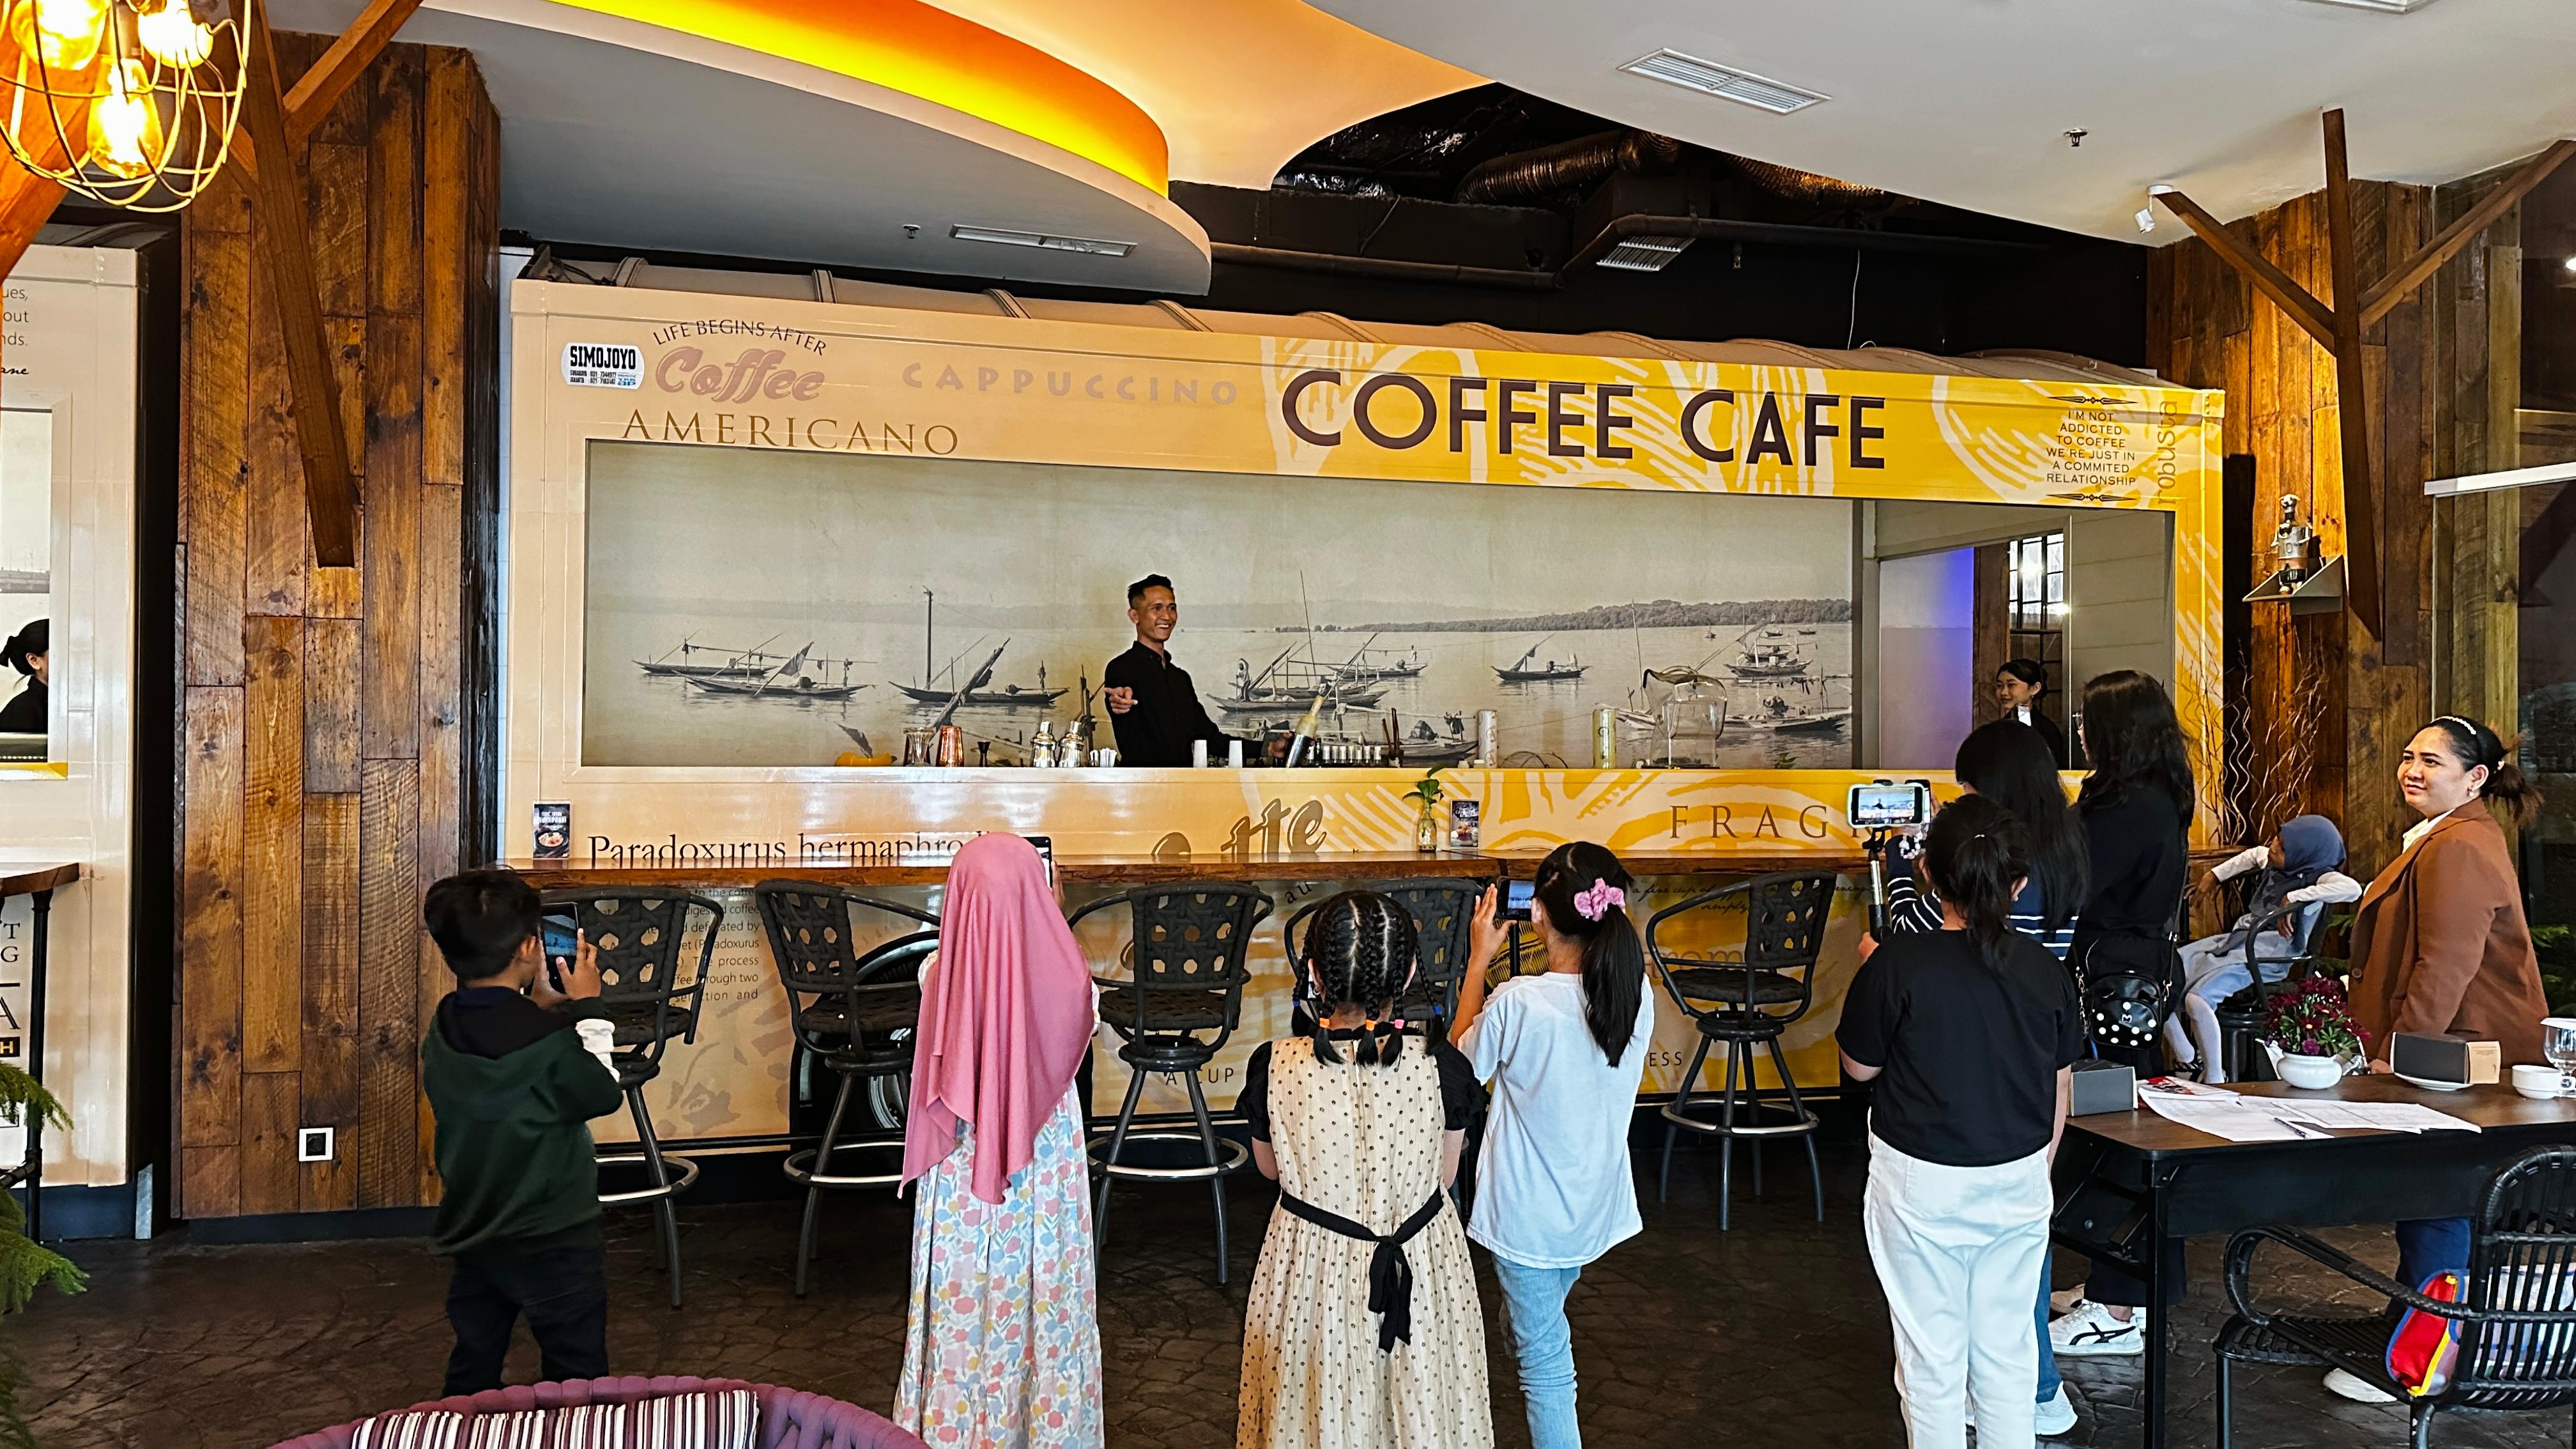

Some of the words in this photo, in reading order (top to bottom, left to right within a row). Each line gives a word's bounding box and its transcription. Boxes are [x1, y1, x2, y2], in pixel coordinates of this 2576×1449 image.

[653, 322, 691, 345] LIFE
[696, 319, 765, 337] BEGINS
[769, 326, 826, 356] AFTER
[570, 346, 636, 369] SIMOJOYO
[656, 346, 825, 404] Coffee
[902, 362, 1237, 406] CAPPUCCINO
[1282, 369, 1634, 460] COFFEE
[1680, 389, 1886, 470] CAFE
[2068, 411, 2084, 420] I'M
[2089, 411, 2113, 422] NOT
[619, 408, 958, 455] AMERICANO
[2060, 423, 2122, 435] ADDICTED
[2056, 435, 2073, 445] TO
[2076, 436, 2126, 448] COFFEE
[2046, 447, 2085, 459] WE'RE
[2089, 450, 2120, 459] JUST
[2124, 452, 2135, 461] IN
[2053, 461, 2060, 470] A
[2064, 461, 2129, 473] COMMITED
[2046, 473, 2136, 486] RELATIONSHIP
[588, 834, 786, 859] Paradoxurus
[747, 921, 760, 931] by
[718, 958, 759, 969] process
[739, 974, 758, 983] two
[737, 988, 758, 1000] and
